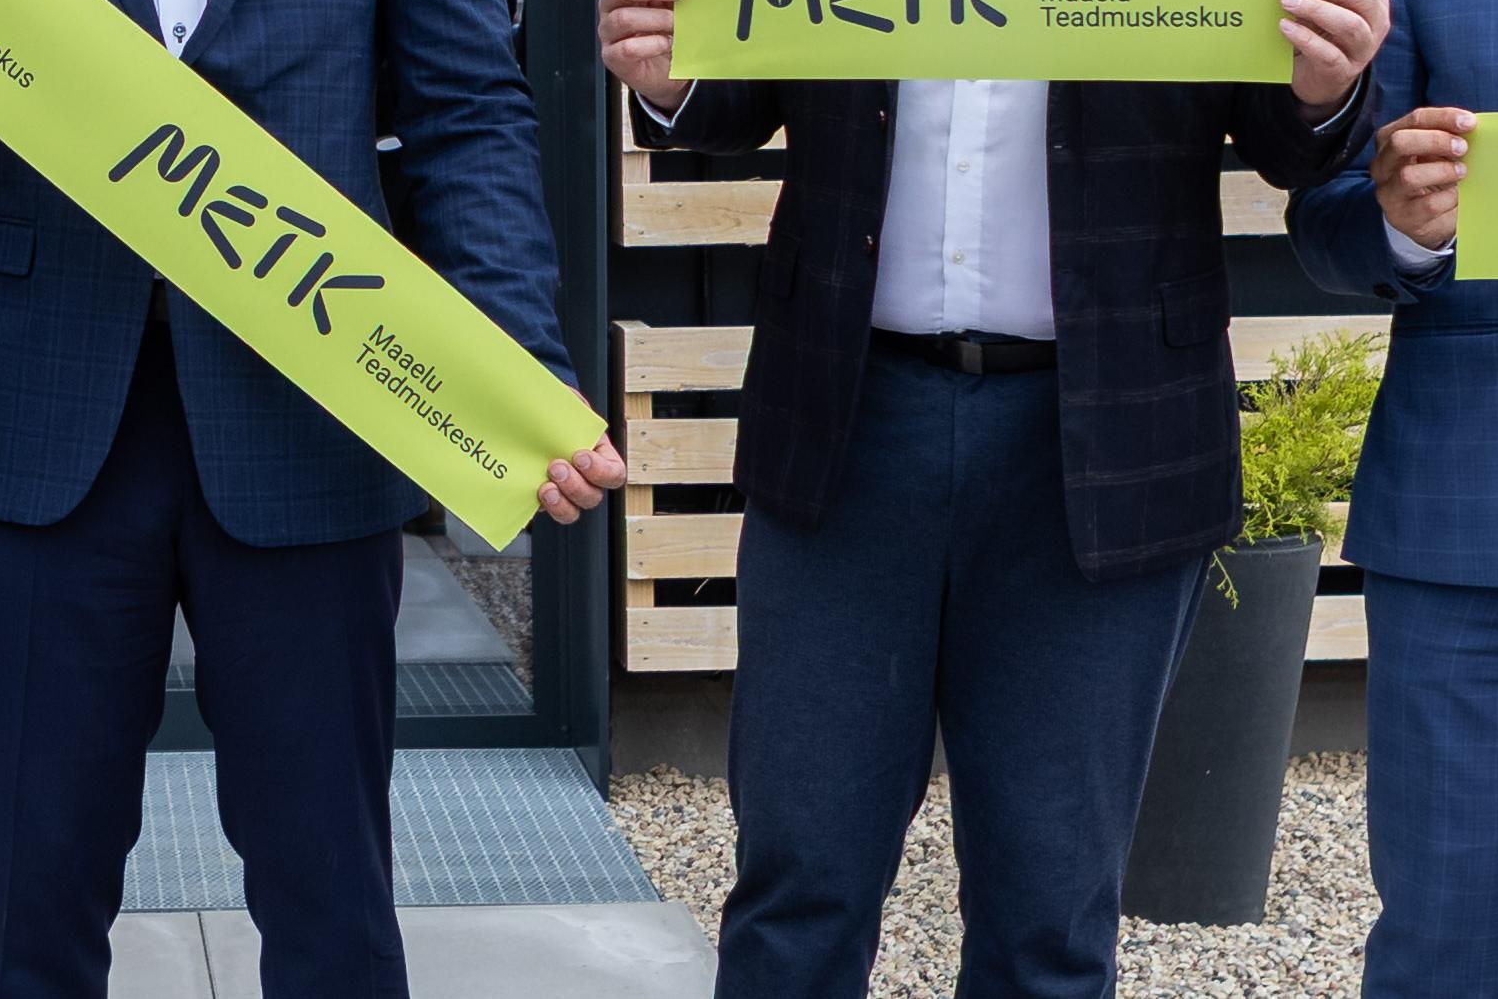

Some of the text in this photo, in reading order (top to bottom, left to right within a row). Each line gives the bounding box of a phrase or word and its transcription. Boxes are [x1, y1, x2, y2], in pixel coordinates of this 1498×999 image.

[1039, 5, 1243, 28] Teadmuskeskus
[107, 123, 386, 336] METK
[355, 342, 509, 480] Teadmuskeskus
[368, 324, 443, 394] Maaelu
